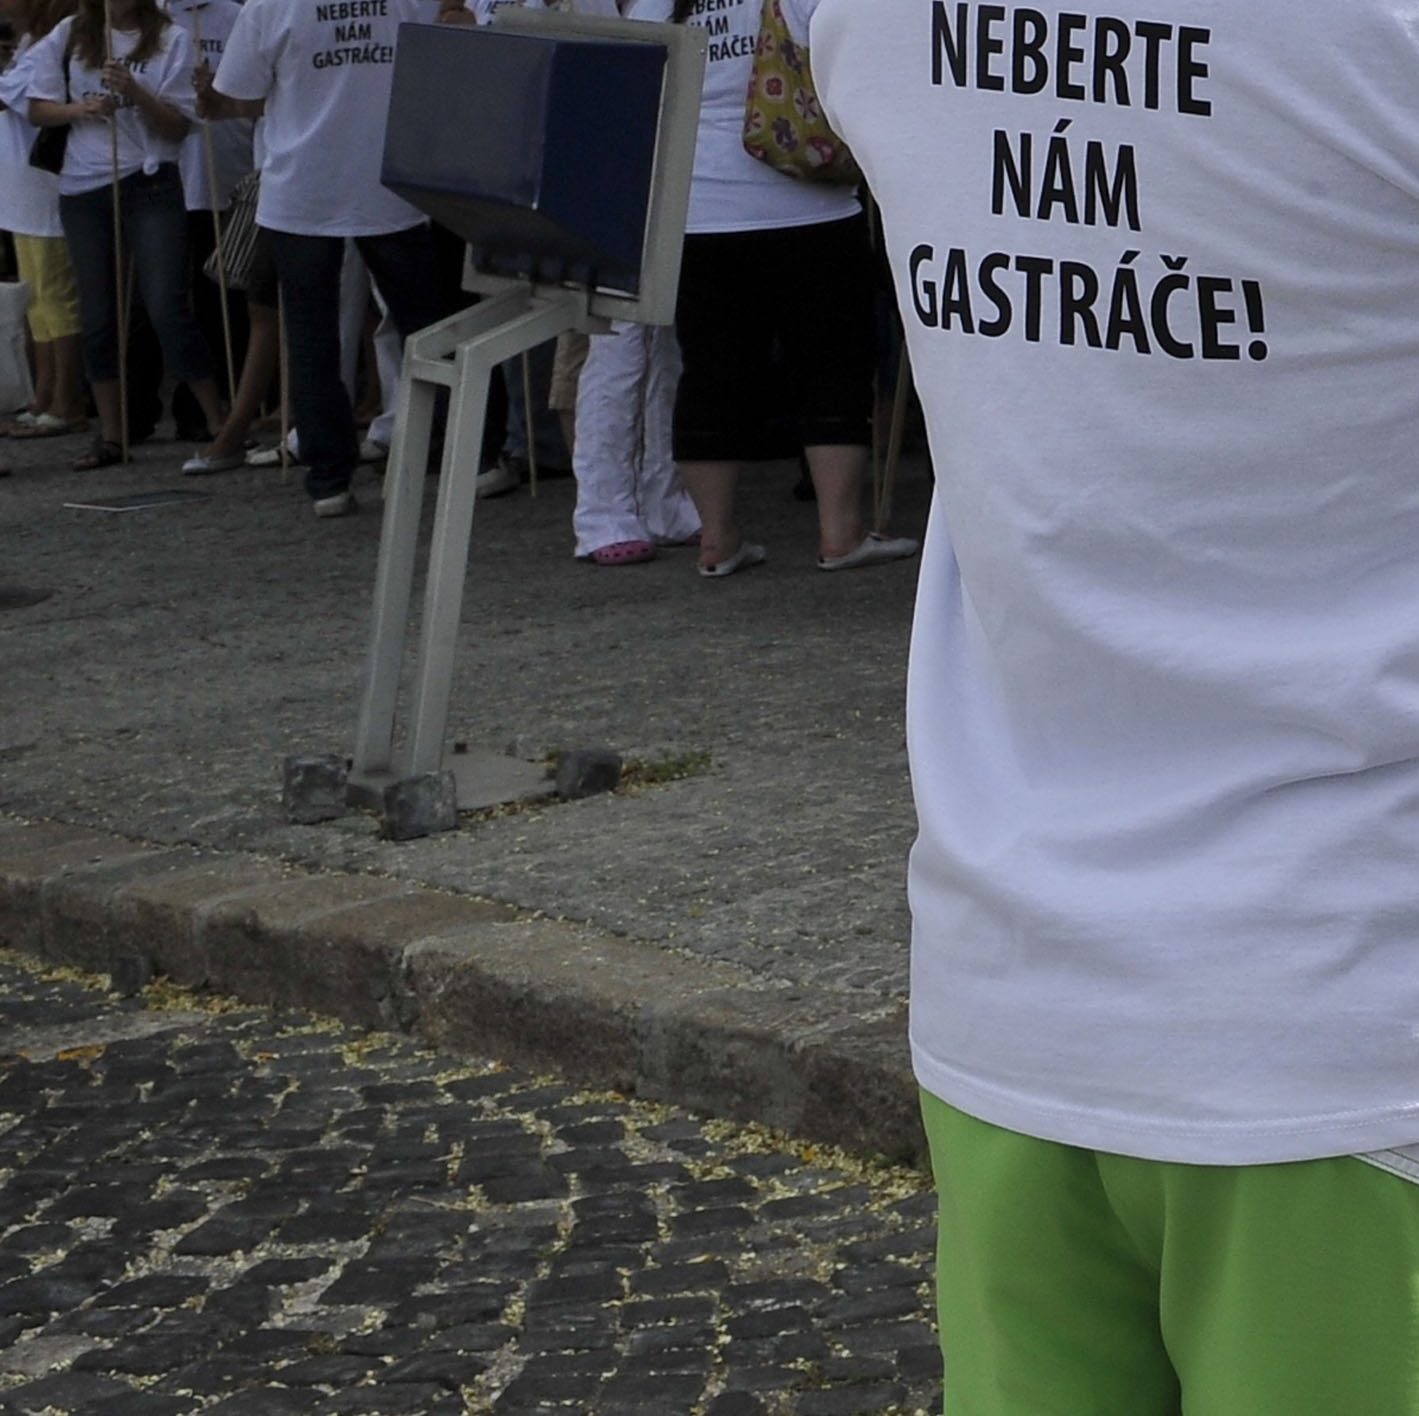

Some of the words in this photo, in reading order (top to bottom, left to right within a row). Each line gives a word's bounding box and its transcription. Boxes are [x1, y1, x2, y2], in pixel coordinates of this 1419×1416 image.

[317, 0, 388, 22] NEBERTE
[335, 23, 372, 43] NÁM
[313, 44, 393, 70] GASTRÁČE!
[709, 34, 755, 62] RÁČE!
[931, 0, 1212, 117] NEBERTE
[991, 118, 1141, 232] NÁM
[909, 244, 1269, 362] GASTRÁČE!
